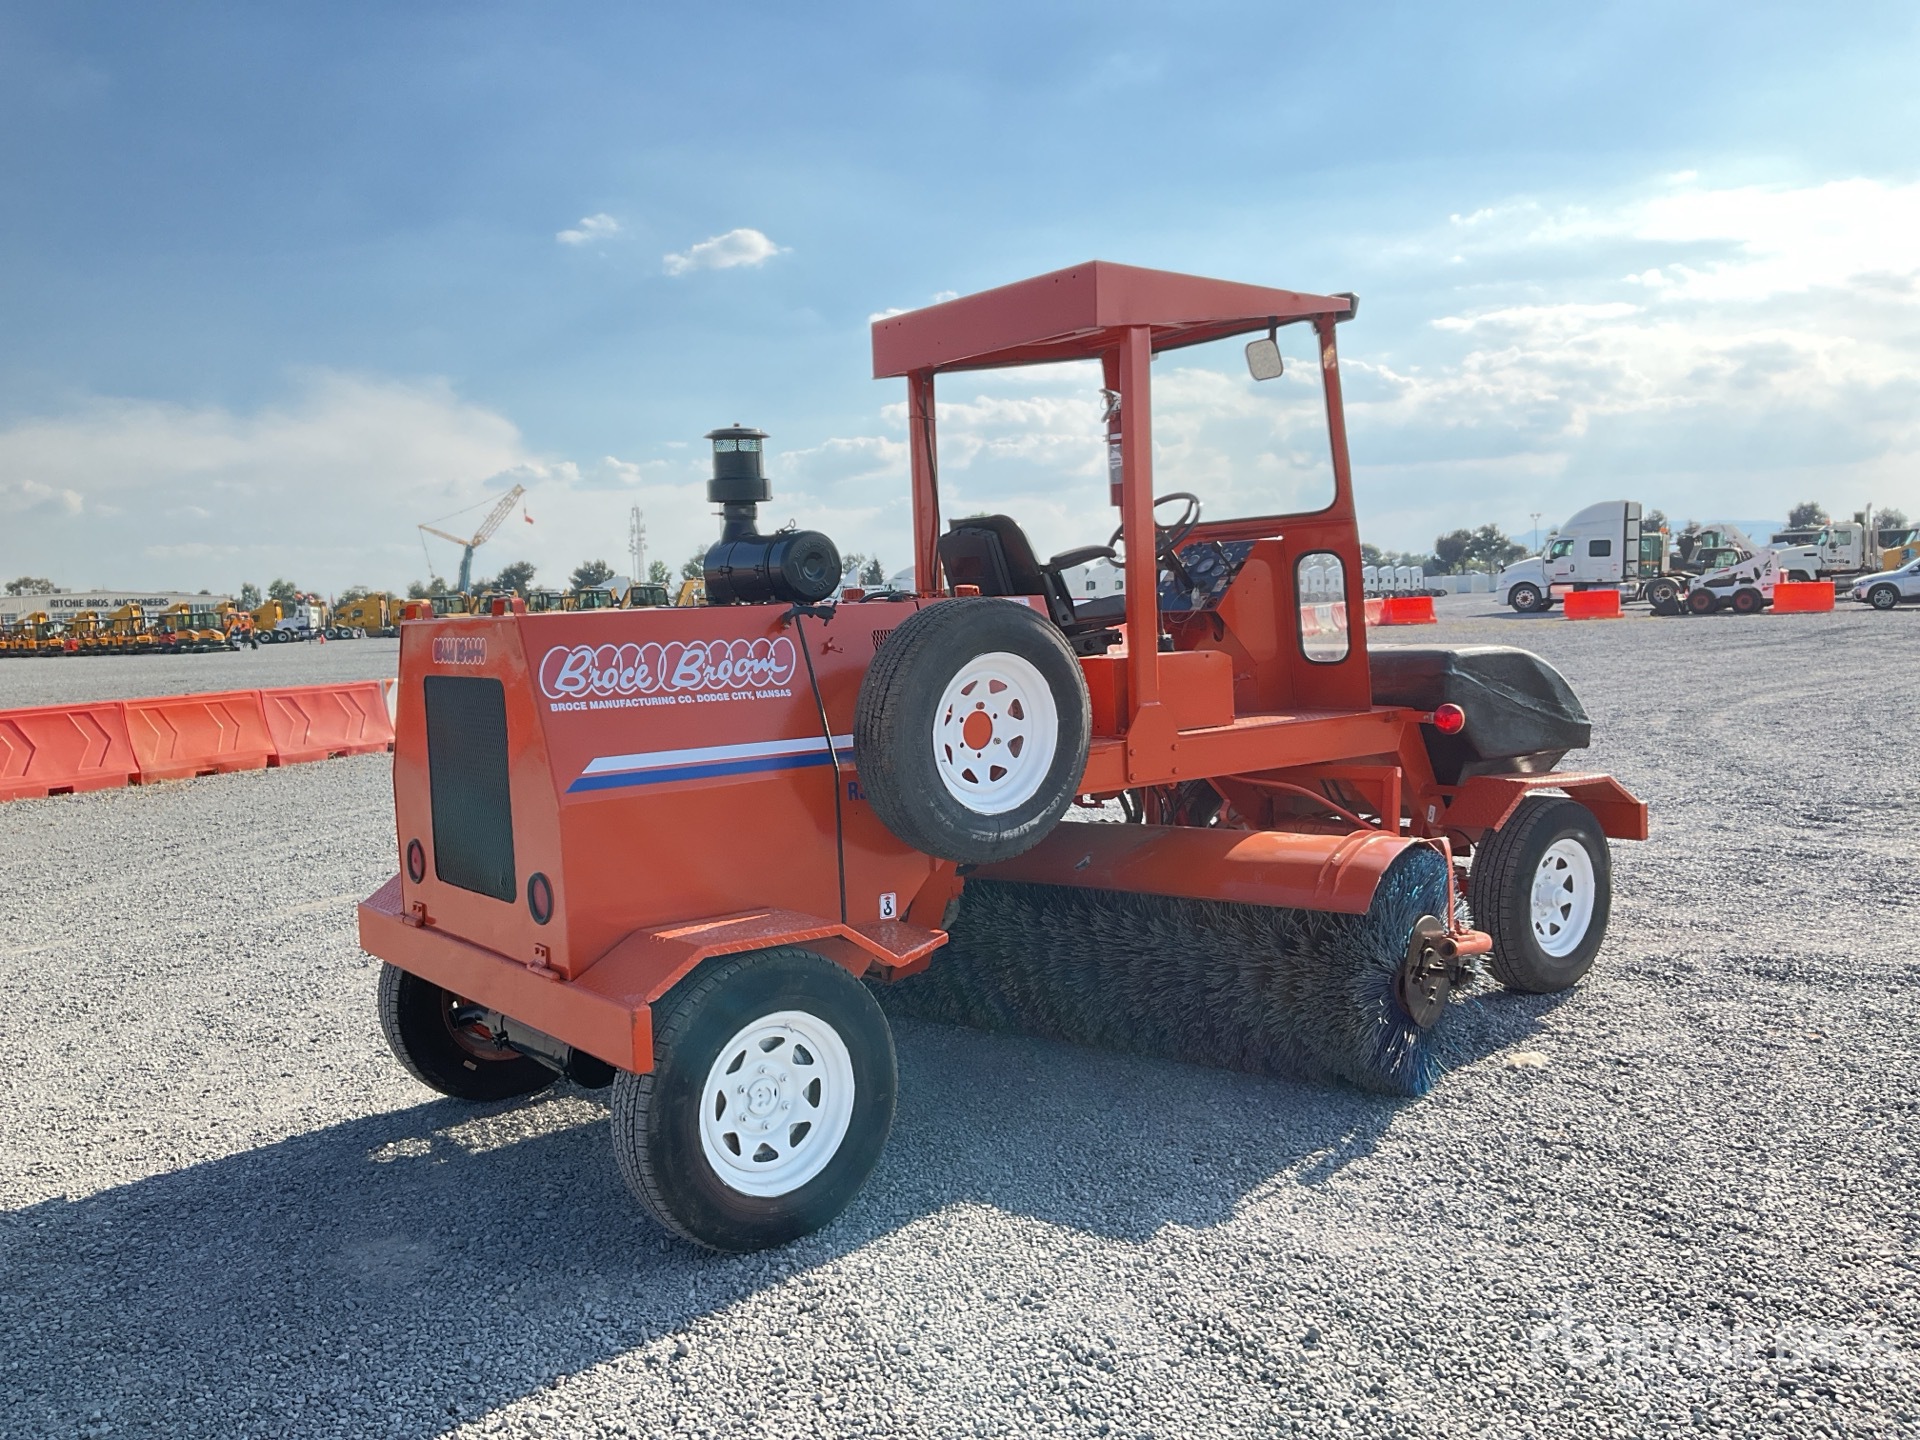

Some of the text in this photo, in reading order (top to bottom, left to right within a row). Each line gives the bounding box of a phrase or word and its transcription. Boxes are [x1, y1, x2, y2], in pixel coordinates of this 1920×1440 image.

[50, 597, 169, 608] RITCHIE BROS. AUCTIONEERS
[554, 648, 787, 692] Broce Broom
[550, 688, 792, 712] BROCE MANUFACTURING CO. DODGE CITY, KANSAS
